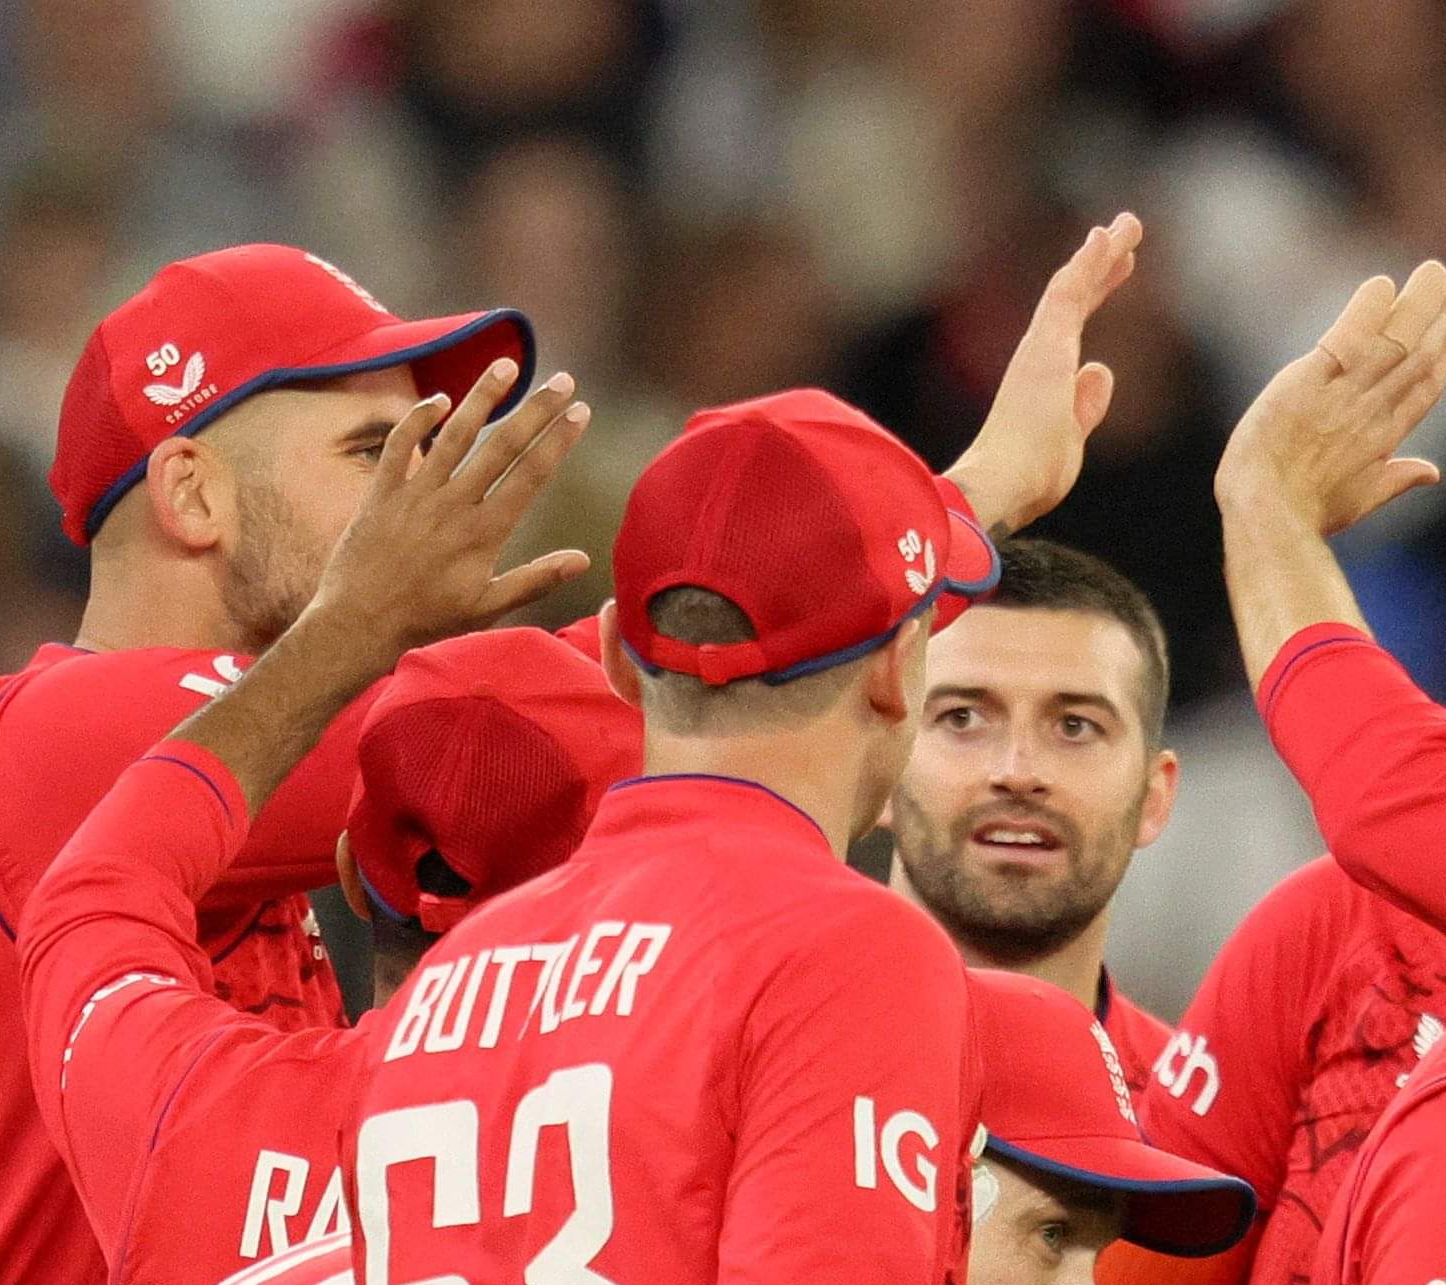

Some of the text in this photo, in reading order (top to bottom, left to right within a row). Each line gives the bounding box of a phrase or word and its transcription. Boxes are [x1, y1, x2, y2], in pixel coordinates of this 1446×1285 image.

[145, 342, 181, 377] 50
[897, 527, 922, 563] 50
[383, 921, 672, 1063] BUTTLER
[854, 1095, 940, 1213] IG
